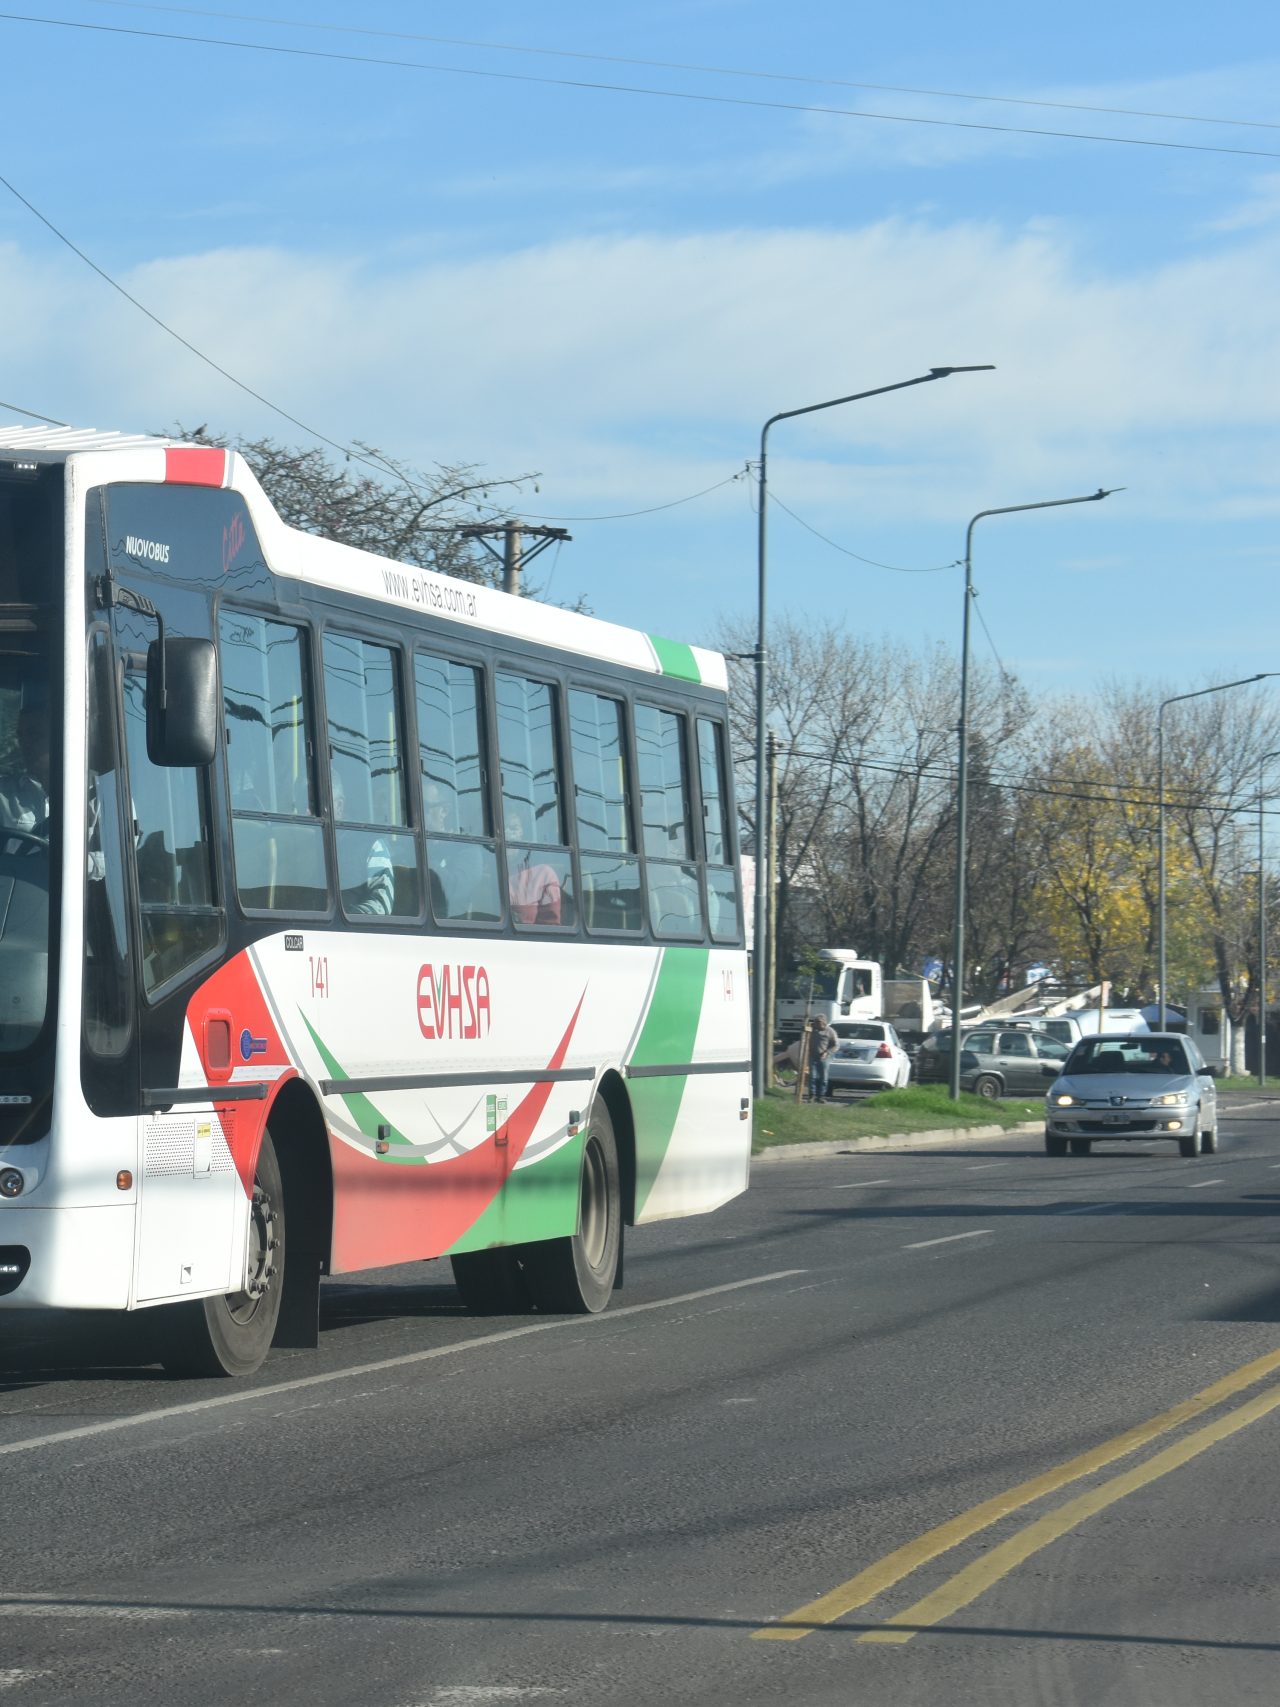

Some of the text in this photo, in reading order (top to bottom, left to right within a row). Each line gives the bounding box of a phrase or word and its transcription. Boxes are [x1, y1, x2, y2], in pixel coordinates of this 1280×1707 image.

[125, 535, 170, 563] NUOVOBUS
[286, 936, 304, 950] COLCAR
[308, 956, 329, 998] 141
[416, 963, 490, 1040] EVHSA
